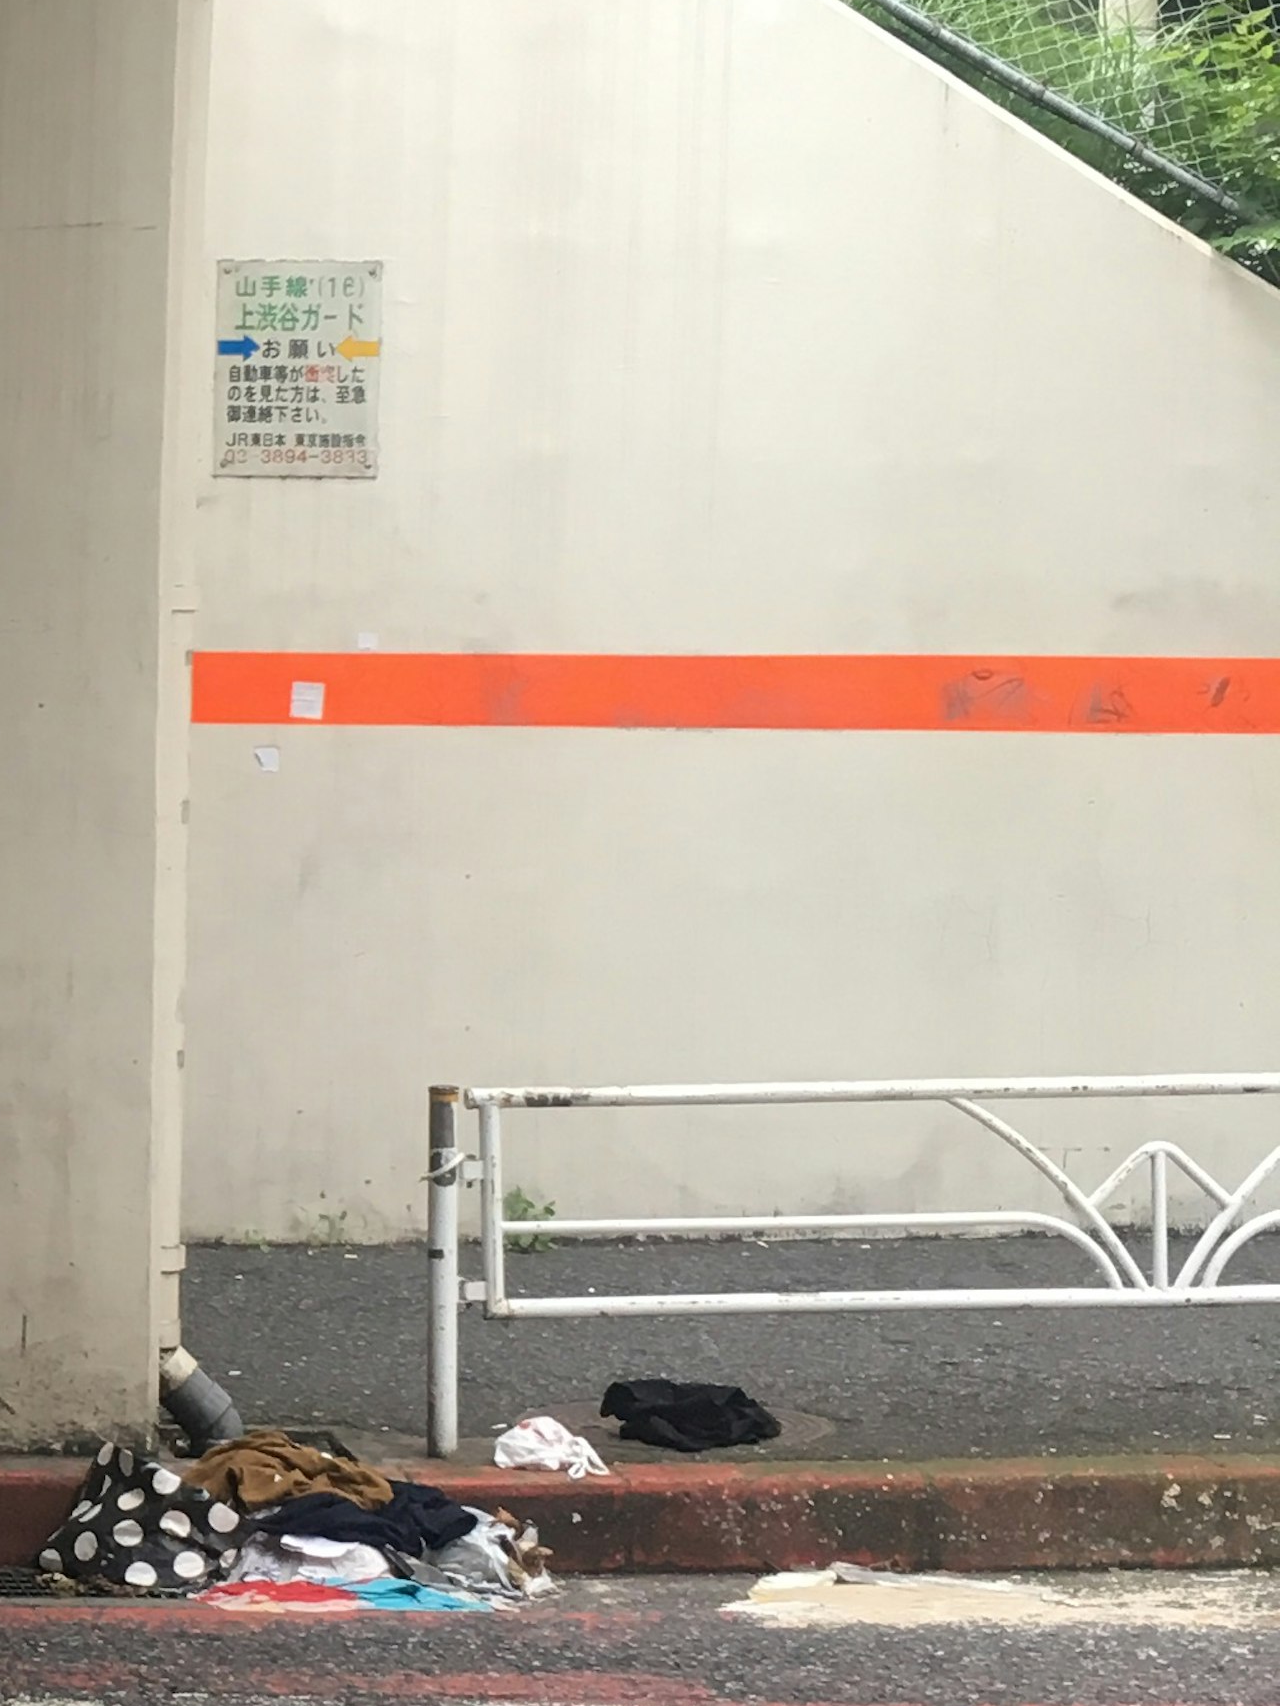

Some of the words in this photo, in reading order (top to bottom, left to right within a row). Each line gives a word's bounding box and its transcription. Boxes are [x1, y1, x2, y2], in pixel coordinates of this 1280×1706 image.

[234, 302, 364, 331] 上渋谷ガード
[262, 339, 336, 359] お願い
